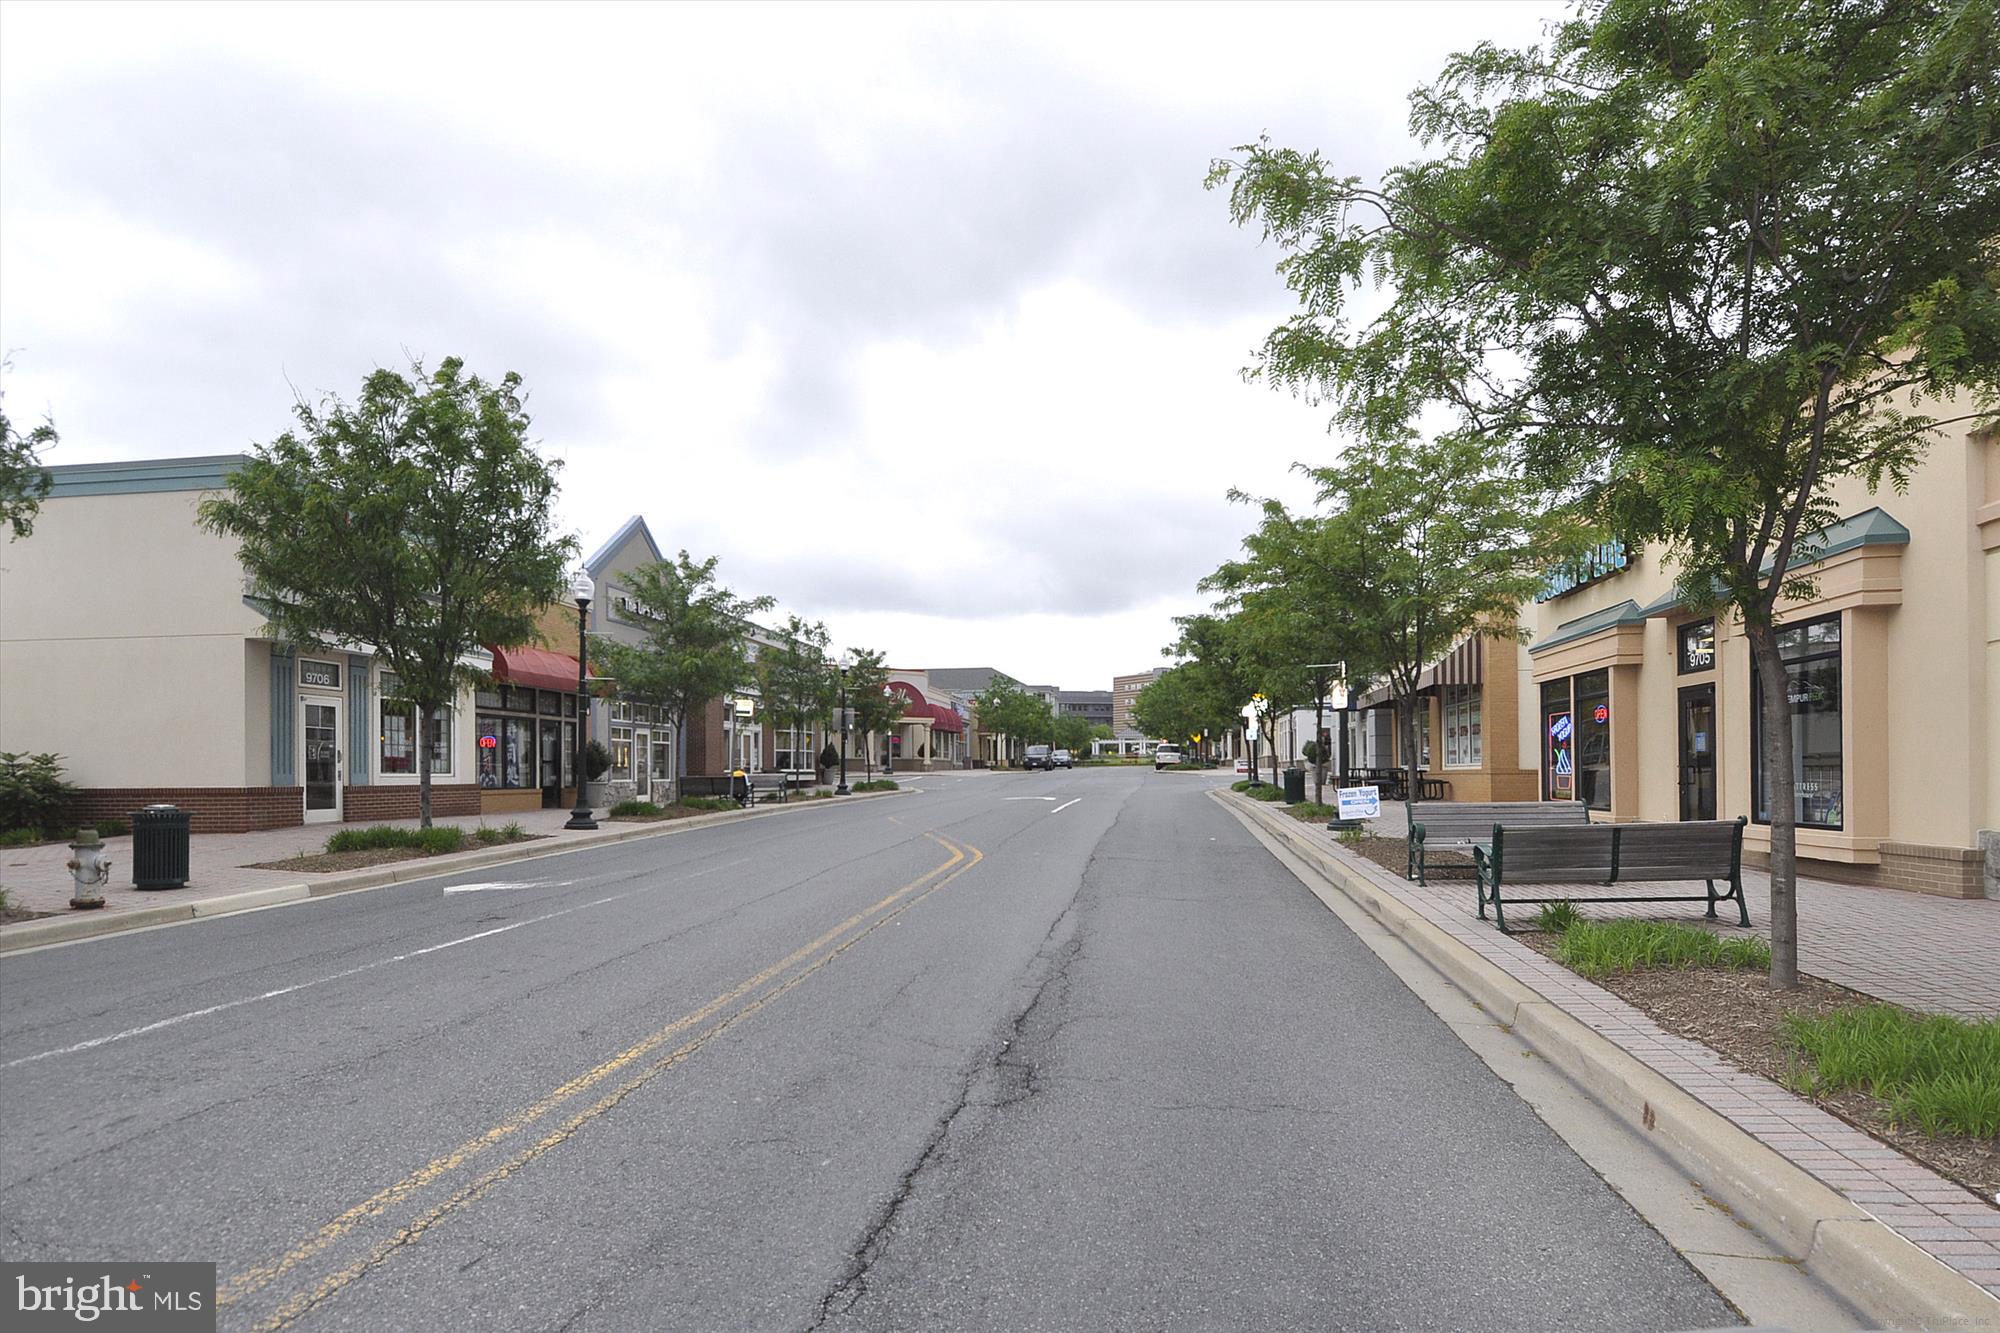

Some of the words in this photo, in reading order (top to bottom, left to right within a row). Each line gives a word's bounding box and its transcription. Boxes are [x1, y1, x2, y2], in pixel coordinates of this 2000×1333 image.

[1690, 653, 1710, 667] 9705
[305, 672, 330, 685] 9706
[1594, 708, 1608, 719] OPEN
[1794, 782, 1818, 791] TTRESS
[1339, 790, 1357, 798] Frozen
[1359, 788, 1377, 798] Yogurt
